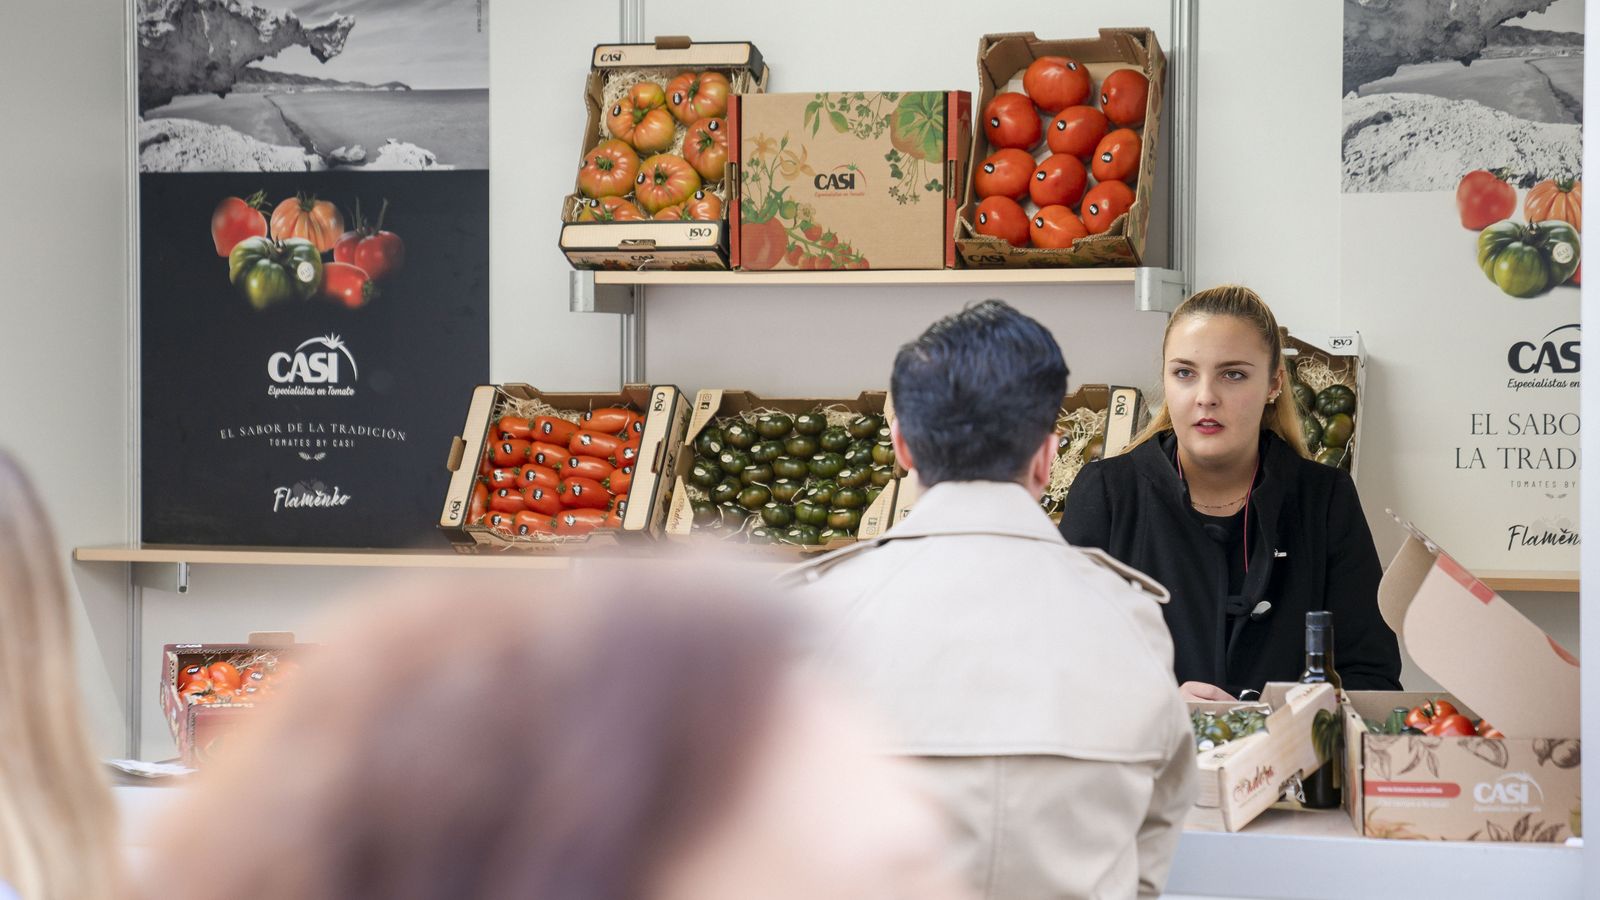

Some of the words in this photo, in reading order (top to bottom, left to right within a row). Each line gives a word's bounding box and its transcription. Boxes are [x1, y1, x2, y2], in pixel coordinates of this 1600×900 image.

[600, 53, 621, 61] CASI
[814, 173, 855, 190] CASI
[689, 228, 712, 238] CASI
[967, 253, 1007, 263] CASI
[267, 352, 338, 383] CASI
[267, 385, 315, 398] Especialistas
[1507, 379, 1567, 391] Especialistas
[653, 392, 665, 411] CASI
[1115, 395, 1127, 416] CASI
[220, 428, 235, 439] EL
[239, 424, 281, 437] SABOR
[287, 423, 303, 433] DE
[309, 423, 325, 433] LA
[330, 423, 406, 441] TRADICIÓN
[1471, 413, 1498, 435] EL
[269, 438, 310, 447] TOMATES
[316, 439, 327, 447] BY
[332, 439, 354, 448] CASI
[1455, 447, 1487, 469] LA
[1496, 447, 1582, 470] TRAD
[1510, 480, 1557, 488] TOMATES
[450, 500, 461, 520] CASI
[1473, 782, 1529, 804] CASI
